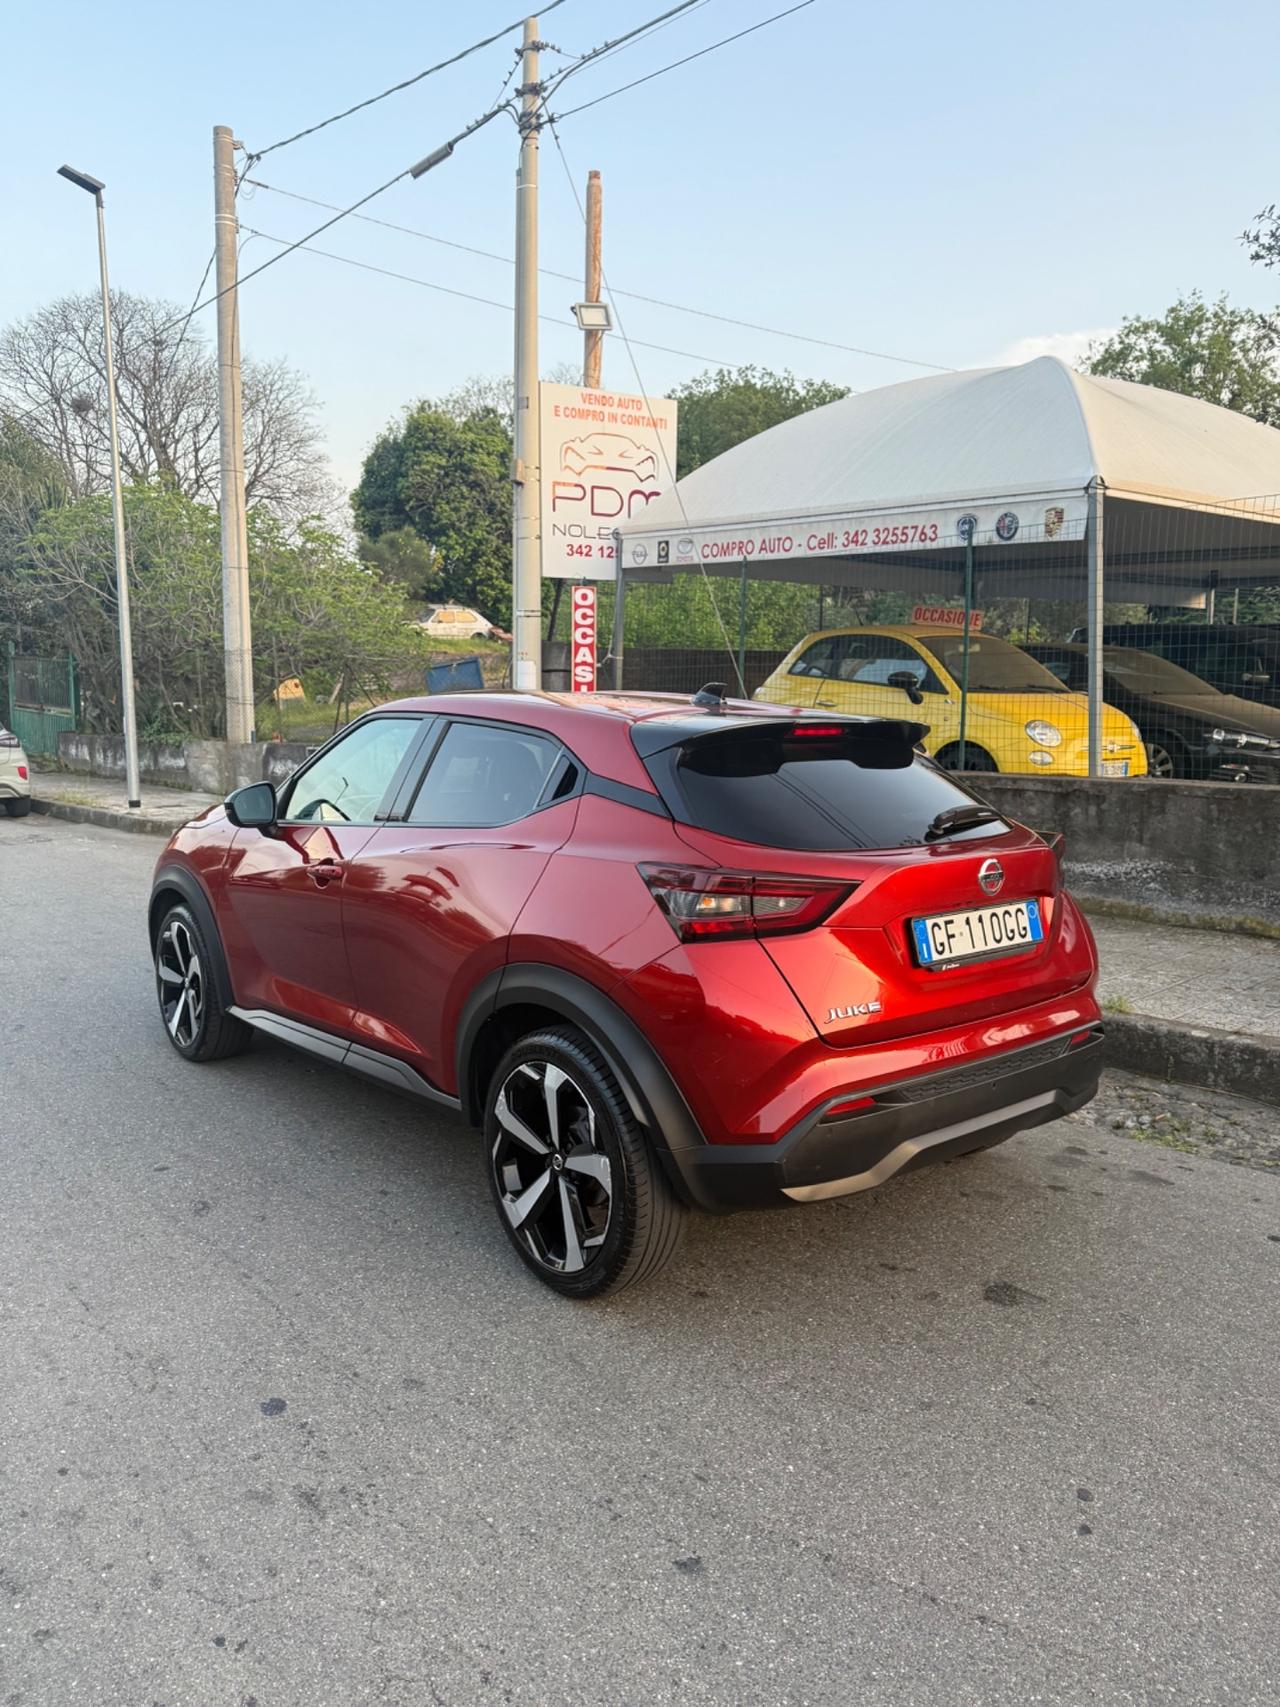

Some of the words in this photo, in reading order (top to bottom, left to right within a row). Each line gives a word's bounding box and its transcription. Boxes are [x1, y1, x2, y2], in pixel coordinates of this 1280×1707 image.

[581, 392, 615, 407] VENDO
[617, 397, 643, 411] AUTO
[554, 405, 561, 417] E
[563, 406, 605, 422] COMPRO
[607, 411, 618, 424] IN
[620, 414, 668, 430] CONTANTI
[566, 543, 592, 557] 342
[701, 539, 755, 558] COMPRO
[758, 536, 793, 554] AUTO
[806, 532, 838, 551] Cell:
[842, 529, 868, 548] 342
[872, 524, 938, 545] 3255763
[824, 1001, 881, 1024] JUKE
